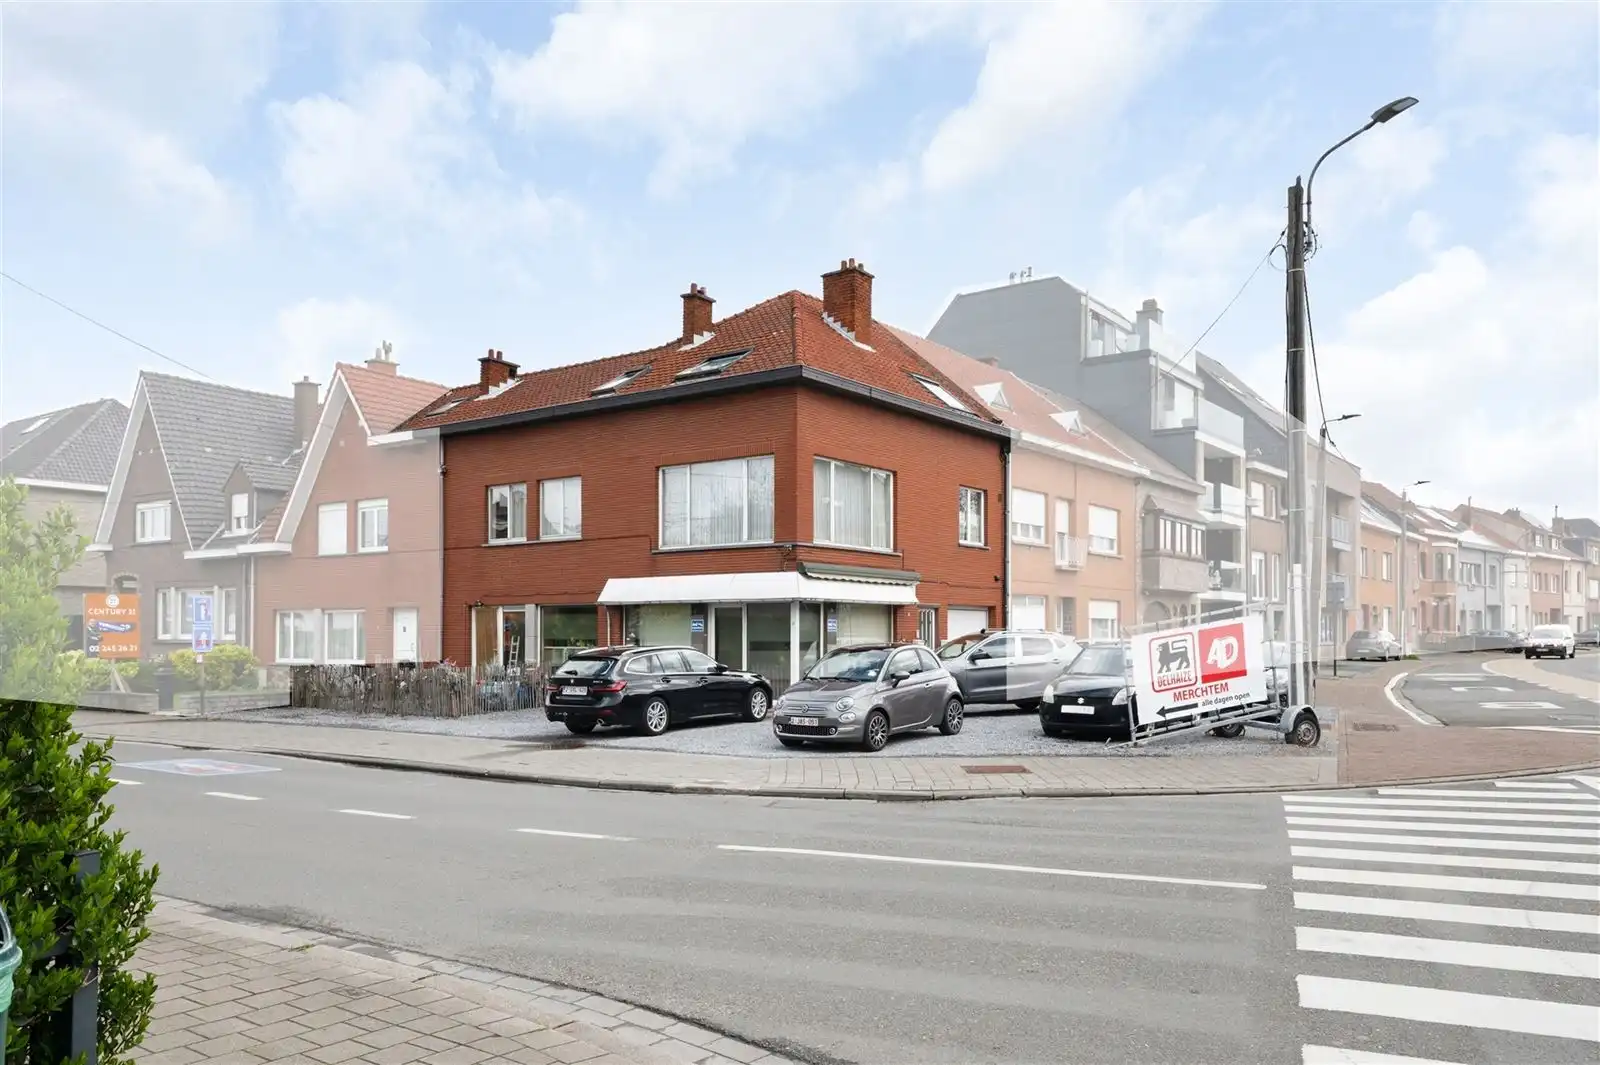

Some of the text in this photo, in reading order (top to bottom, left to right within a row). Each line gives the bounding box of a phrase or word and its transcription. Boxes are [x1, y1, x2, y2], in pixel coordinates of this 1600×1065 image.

[88, 607, 127, 616] CENTURY
[1206, 635, 1239, 669] AD
[1157, 670, 1193, 688] DELHAIZE
[1173, 682, 1229, 702] MERCHTEM
[1214, 695, 1234, 705] dagen
[1234, 692, 1251, 701] open
